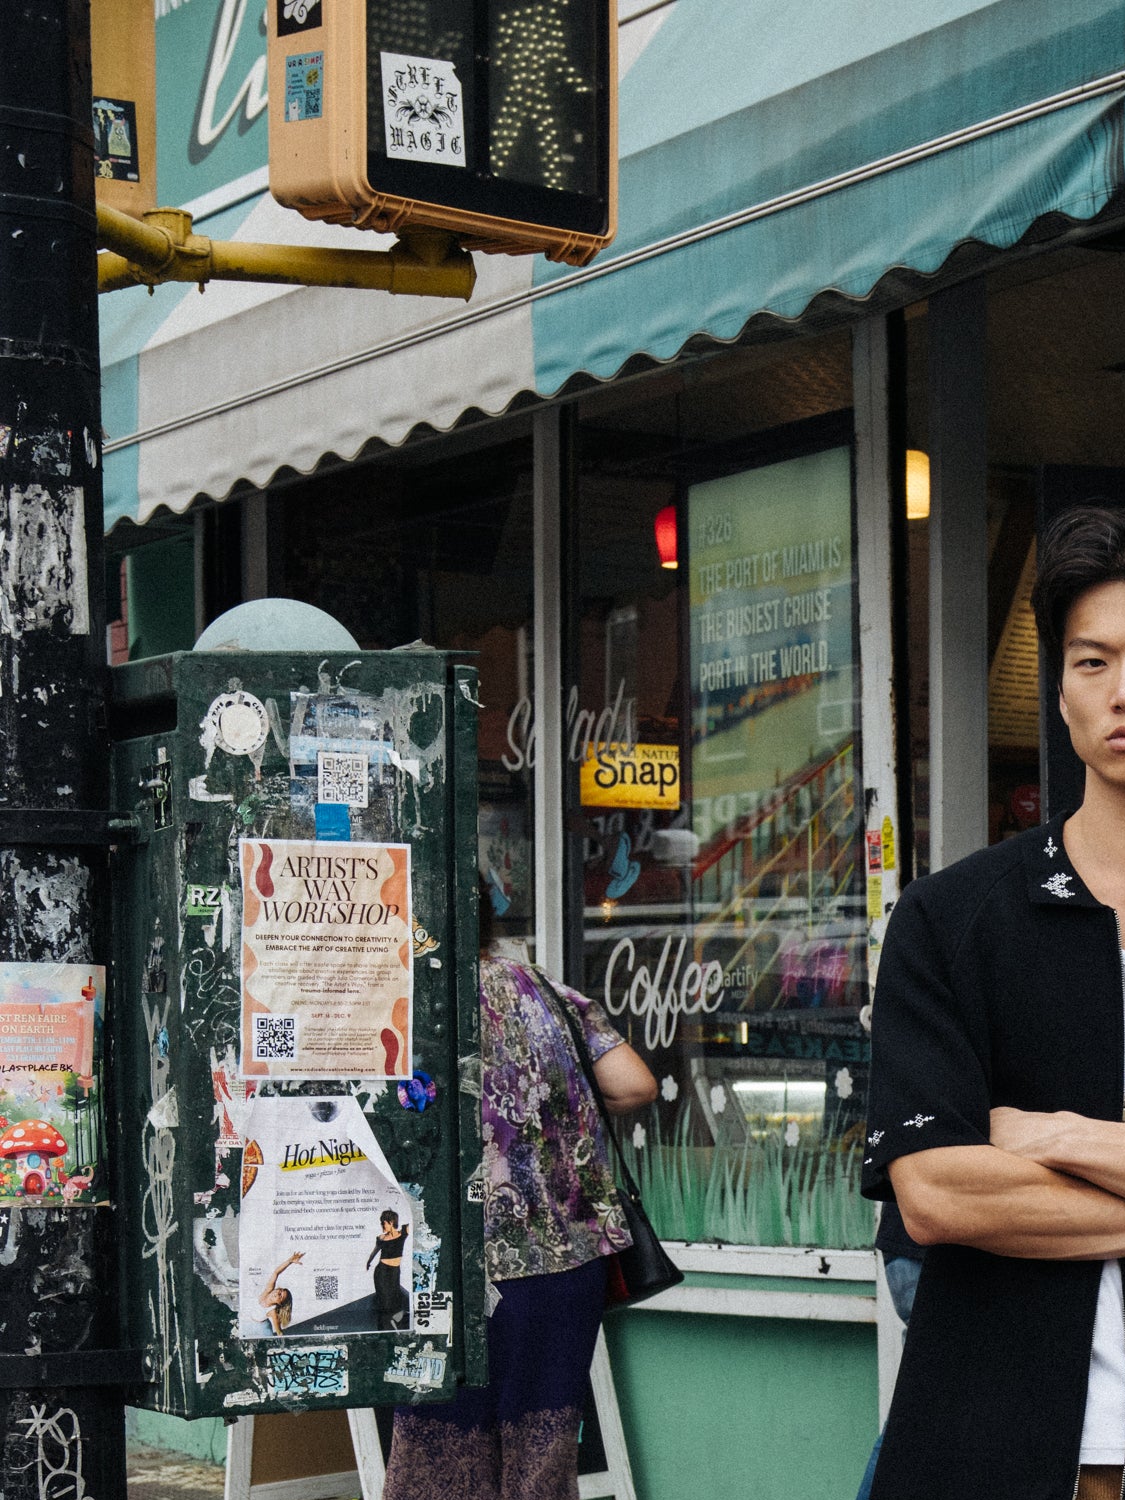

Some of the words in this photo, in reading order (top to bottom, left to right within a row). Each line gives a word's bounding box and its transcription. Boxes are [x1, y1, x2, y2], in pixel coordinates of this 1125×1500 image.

[387, 64, 458, 113] STREET
[389, 125, 462, 155] MAGIC
[699, 563, 723, 595] THE
[725, 553, 760, 589] PORT
[762, 548, 781, 582] OF
[782, 541, 825, 577] MIAMI
[828, 536, 842, 568] IS
[699, 612, 724, 644] THE
[726, 600, 781, 640] BUSIEST
[783, 589, 832, 628] CRUISE
[700, 658, 733, 693] PORT
[735, 655, 749, 687] IN
[751, 649, 777, 683] THE
[779, 640, 832, 678] WORLD.
[502, 678, 640, 773] Slads
[594, 749, 678, 797] Snap
[280, 855, 379, 880] ARTIST'S
[304, 879, 356, 902] WAY
[263, 900, 400, 925] WORKSHOP
[604, 933, 725, 1050] Coffee
[1, 1024, 18, 1034] ON
[20, 1025, 54, 1034] EARTH
[13, 1014, 35, 1023] REN
[38, 1014, 67, 1024] FAIRE
[281, 1142, 316, 1169] Hot
[319, 1138, 367, 1167] Nigh
[417, 1292, 431, 1328] caps
[431, 1292, 448, 1311] all
